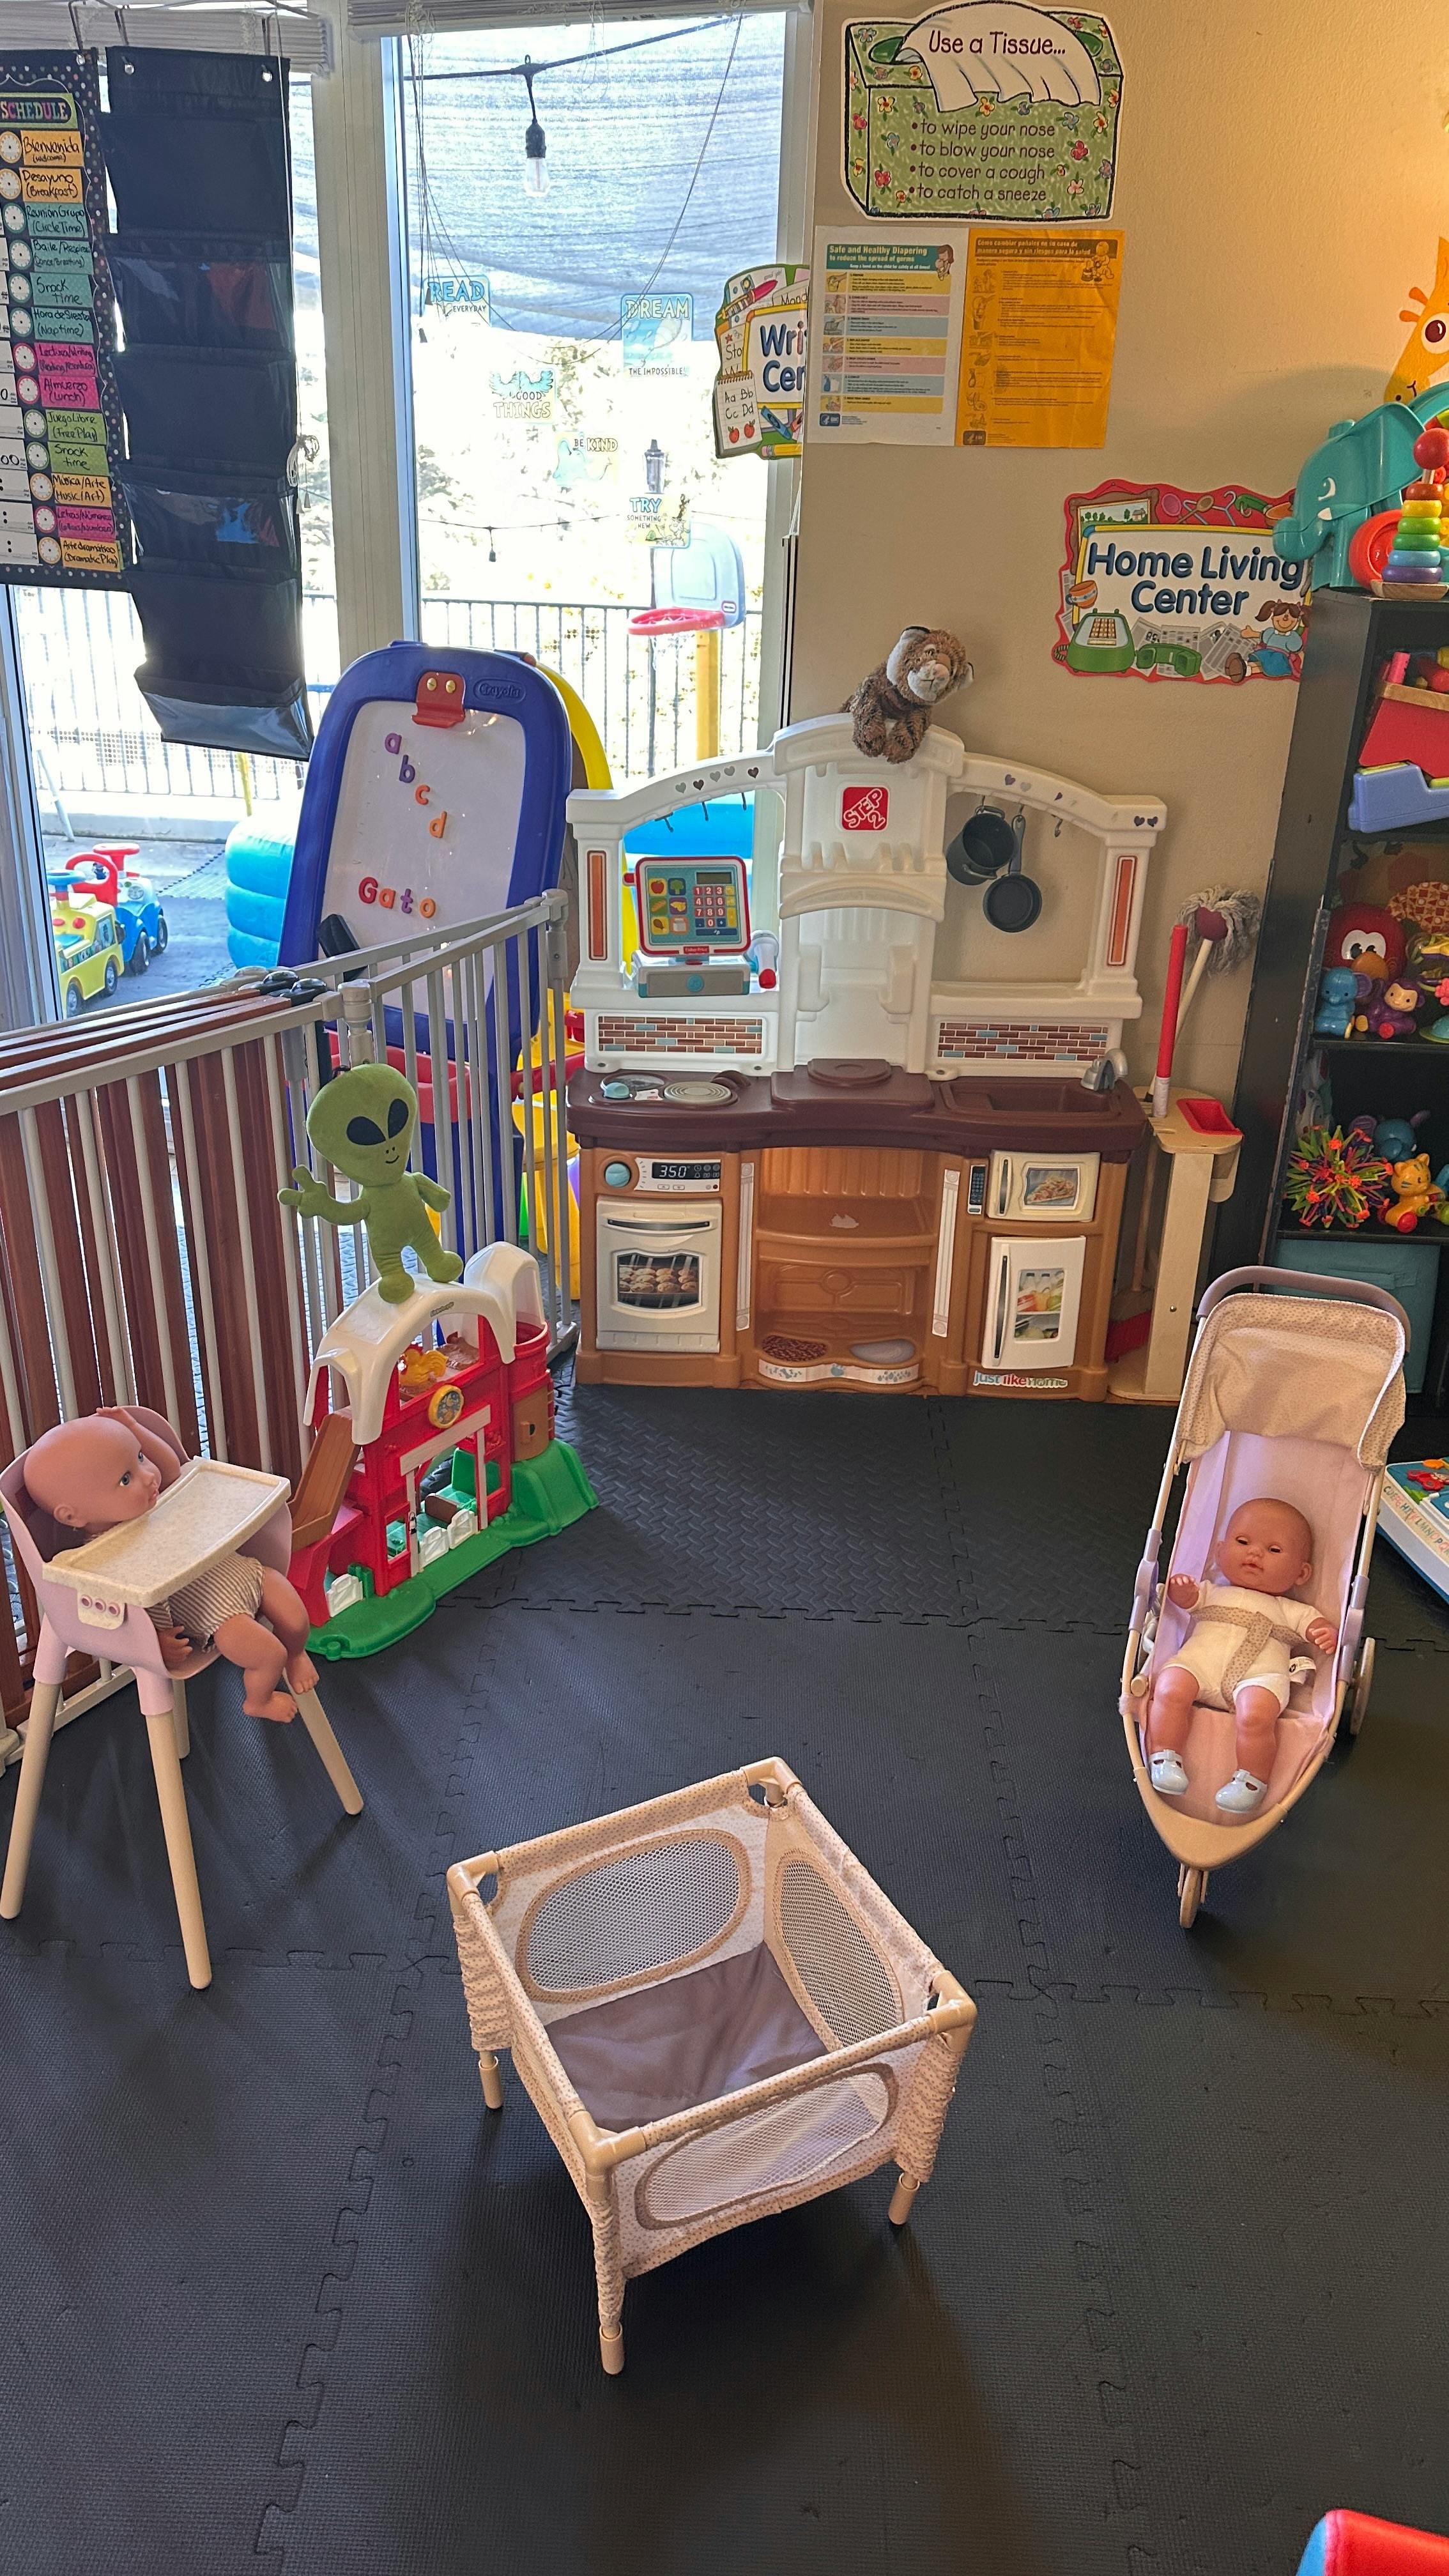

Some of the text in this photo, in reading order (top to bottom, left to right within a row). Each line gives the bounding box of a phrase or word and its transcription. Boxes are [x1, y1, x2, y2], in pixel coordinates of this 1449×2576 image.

[929, 30, 1066, 54] Use a Tissue...
[0, 102, 68, 120] SCHEDULE
[921, 119, 1055, 140] to wipe your nose
[23, 136, 79, 154] Bienvenida
[919, 140, 1055, 162] to blow your nose
[22, 170, 73, 185] Desayuno
[919, 162, 1045, 185] to cover a cough
[26, 183, 78, 199] (Breakfast)
[917, 183, 1046, 201] to catch a sneeze
[830, 245, 846, 254] Safe
[863, 245, 891, 256] Healthy
[893, 247, 928, 256] Diapering
[36, 276, 69, 293] Snack
[427, 280, 485, 302] READ
[625, 297, 689, 319] DREAM
[38, 324, 84, 337] (Naptime)
[760, 321, 807, 356] Wri
[629, 367, 686, 376] THE IMPOSSIBLE!
[43, 378, 88, 391] Almuerzo
[49, 389, 86, 407] (Lunch)
[516, 391, 542, 401] GOOD
[725, 387, 753, 403] Aa Bb
[493, 401, 551, 418] THINGS
[742, 401, 753, 417] Dd
[54, 443, 88, 457] Snack
[574, 438, 618, 452] BE KIND
[629, 497, 662, 513] TRY
[1087, 542, 1305, 590] Home Living
[1131, 580, 1250, 615] Center
[478, 682, 522, 699] Crayola
[385, 732, 402, 755] a
[399, 755, 415, 783] b
[415, 785, 431, 805] c
[843, 788, 882, 828] STEP
[429, 811, 447, 838] d
[868, 810, 886, 829] 2
[358, 877, 436, 919] Gato
[706, 887, 712, 895] 2
[716, 886, 723, 894] 3
[717, 897, 723, 905] 6
[696, 908, 702, 917] 7
[707, 908, 713, 916] 8
